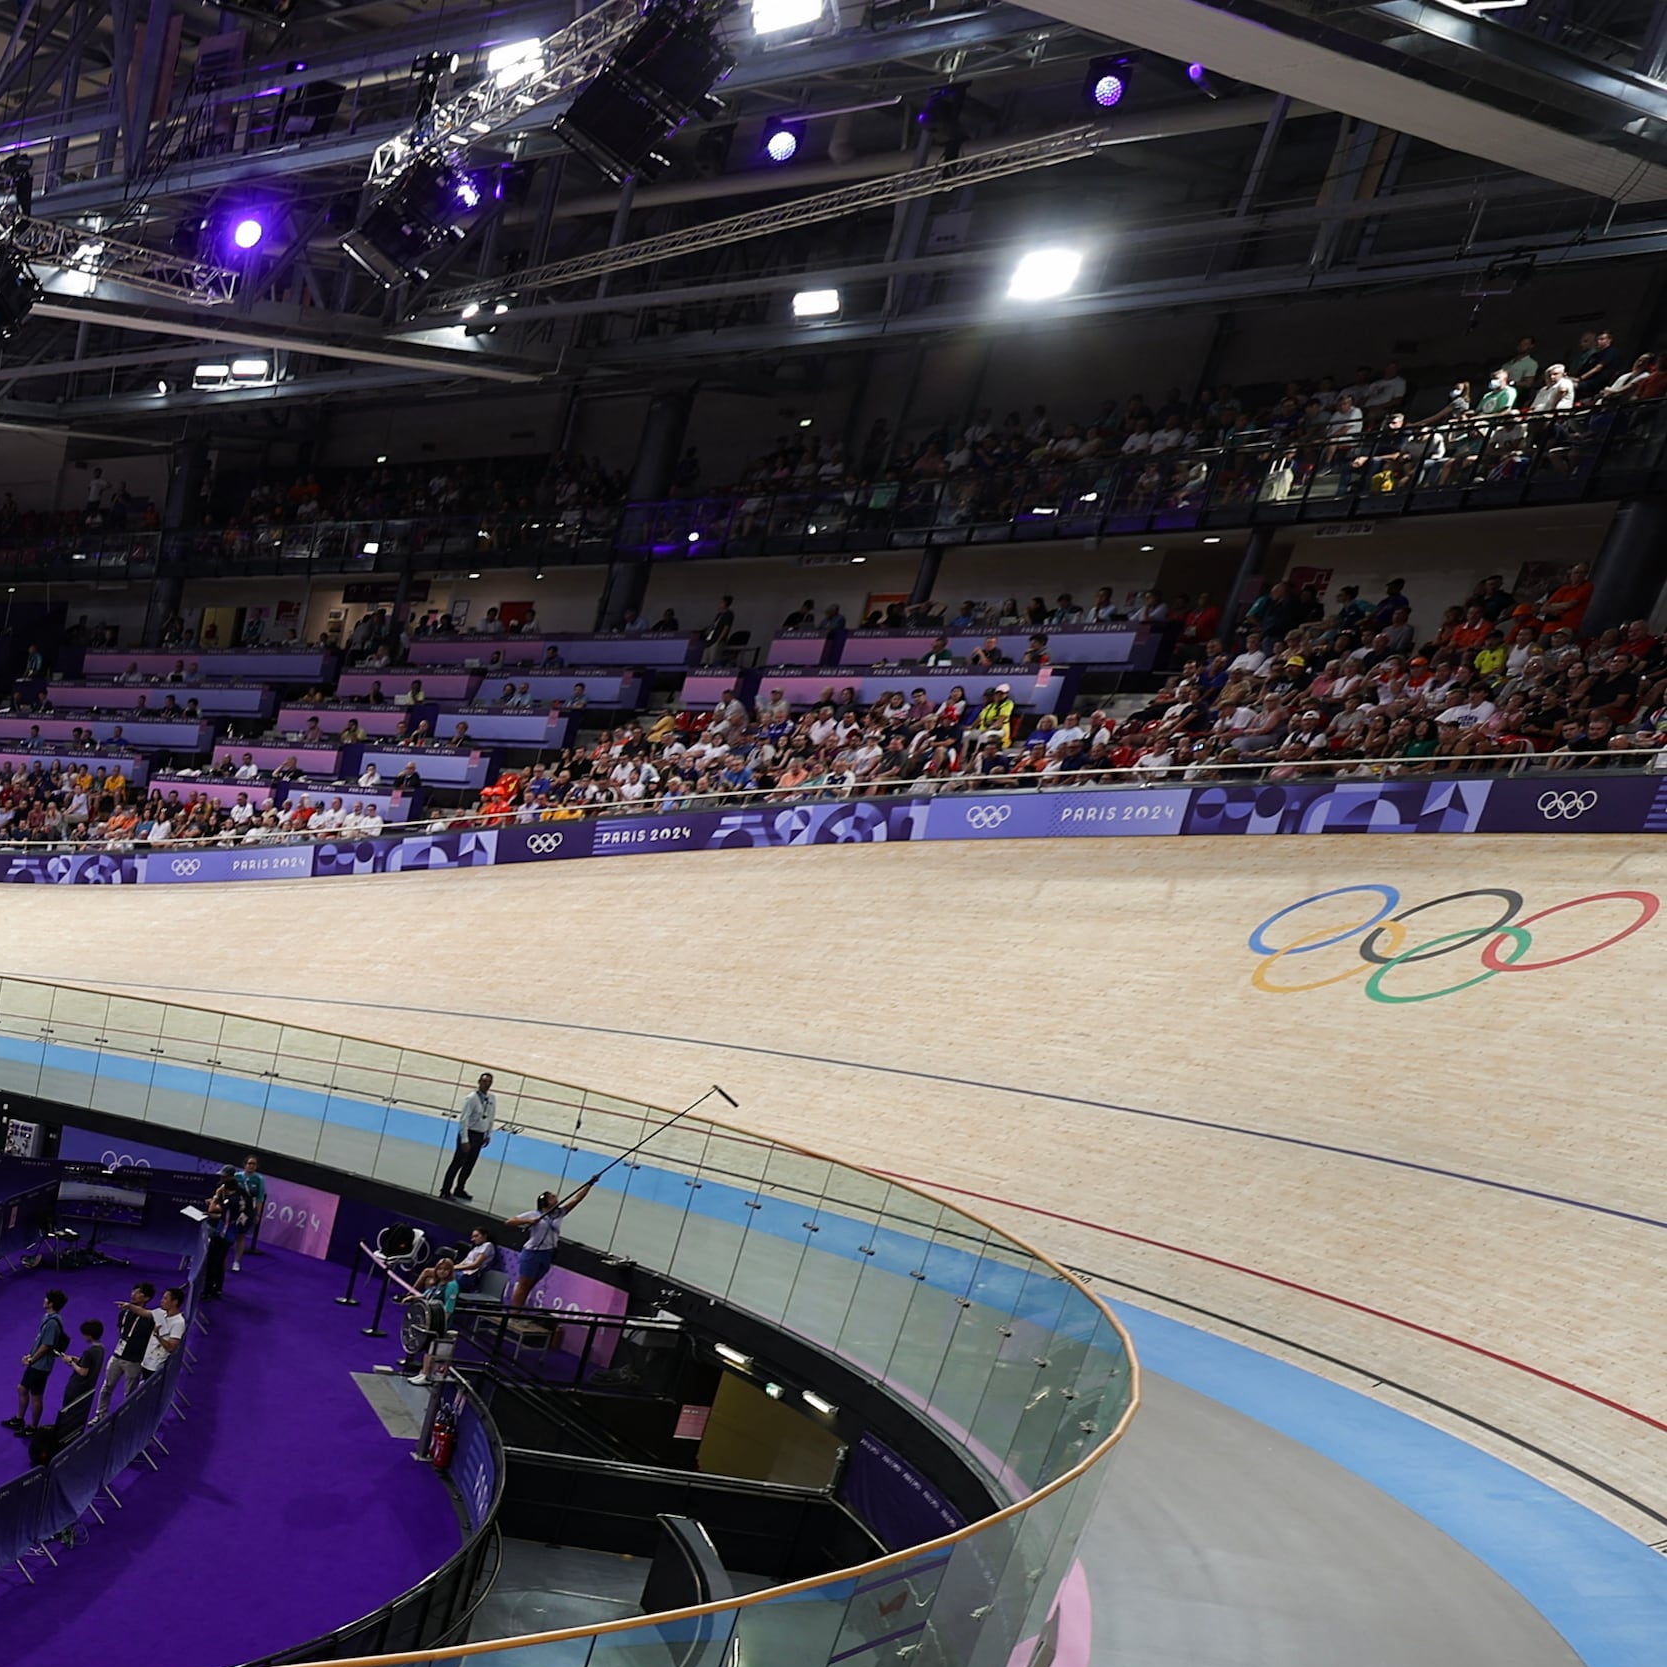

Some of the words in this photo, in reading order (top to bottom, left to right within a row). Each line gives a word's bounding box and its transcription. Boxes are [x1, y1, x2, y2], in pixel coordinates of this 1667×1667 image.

[1059, 805, 1119, 822] PARIS
[1121, 804, 1176, 821] 2024
[600, 831, 647, 846] PARIS
[649, 826, 692, 844] 2024
[232, 860, 269, 874] PARIS
[272, 857, 307, 871] 2024
[267, 1201, 320, 1234] 2024
